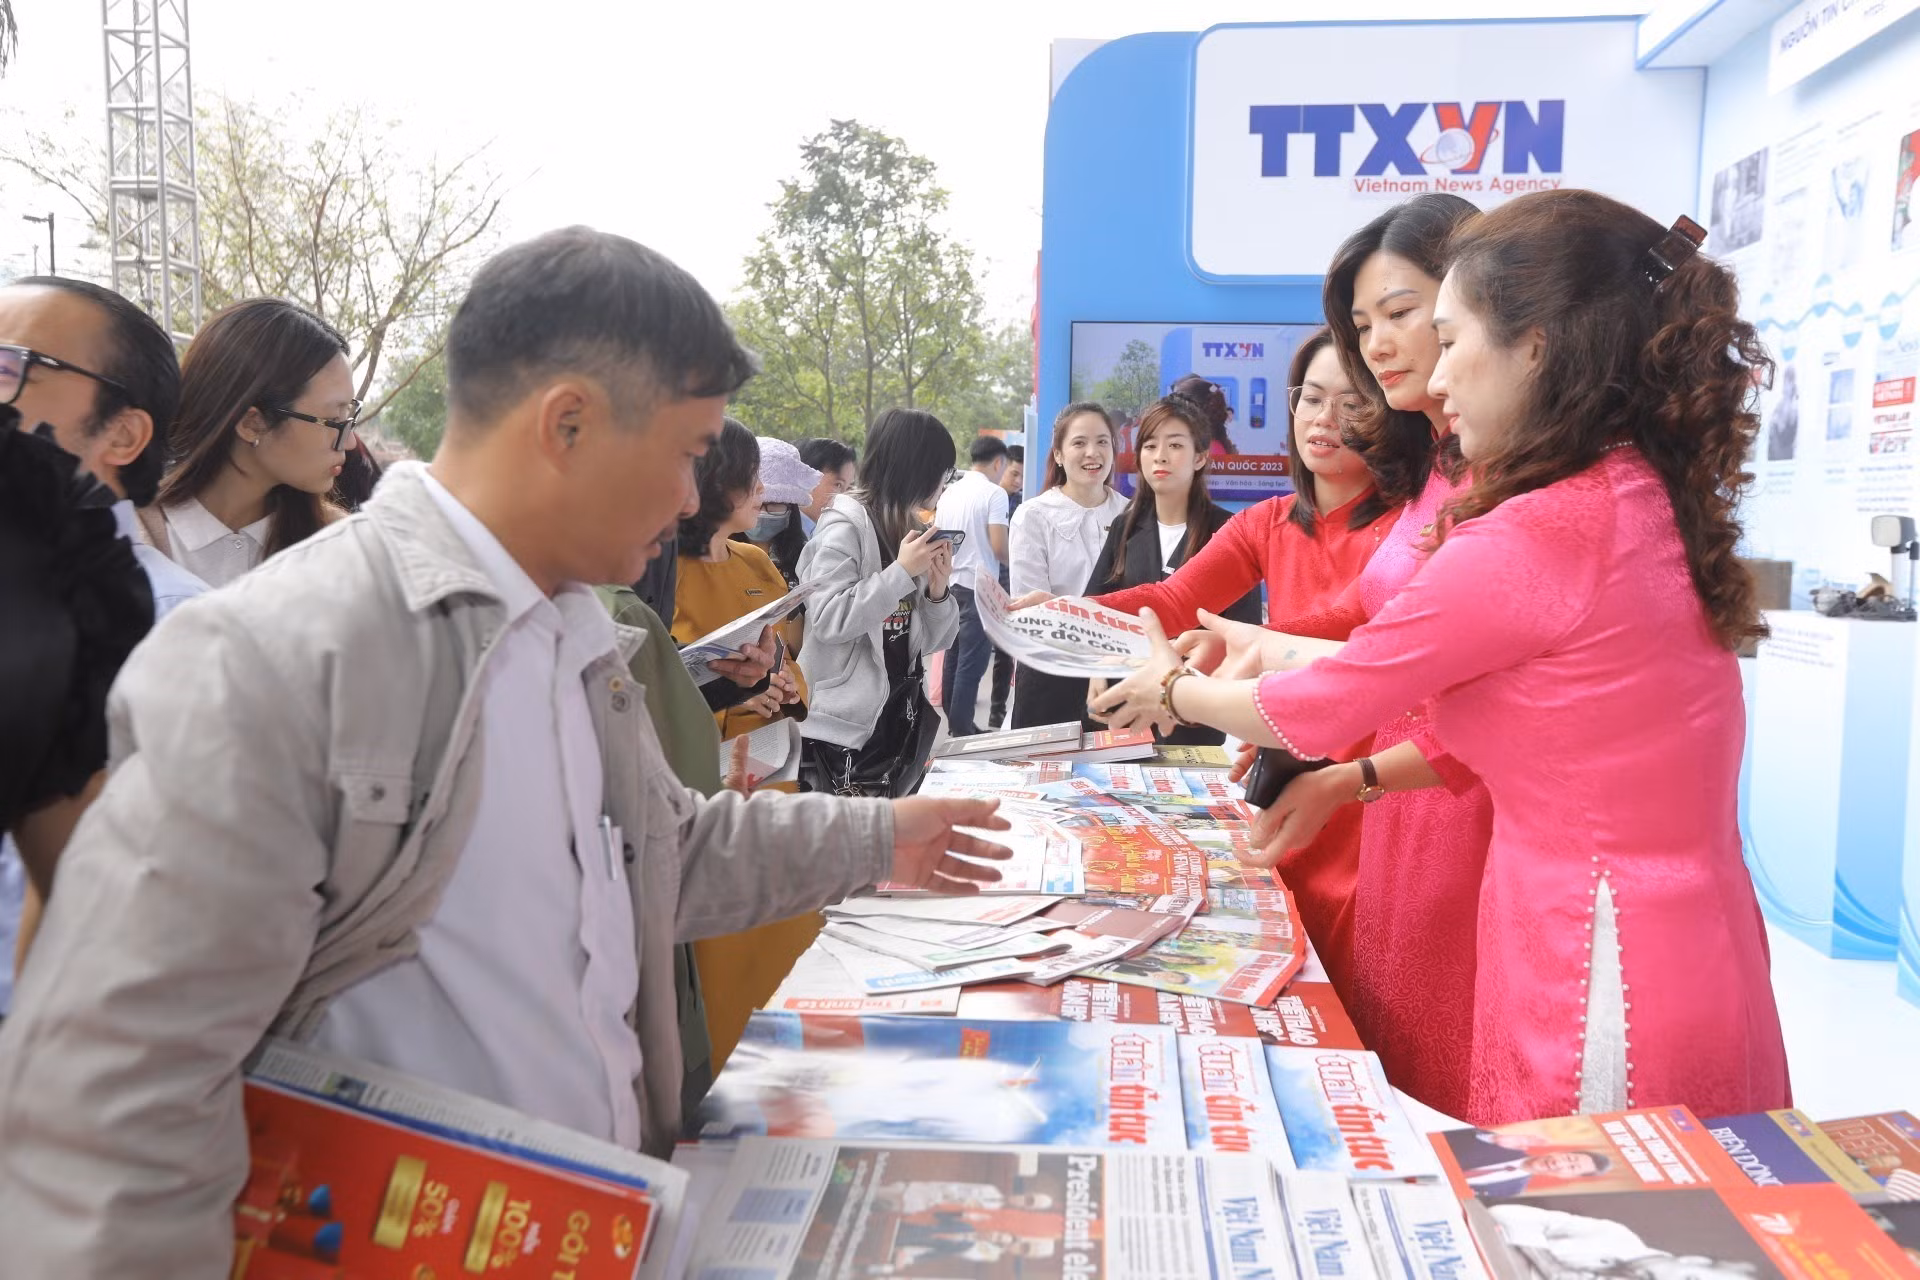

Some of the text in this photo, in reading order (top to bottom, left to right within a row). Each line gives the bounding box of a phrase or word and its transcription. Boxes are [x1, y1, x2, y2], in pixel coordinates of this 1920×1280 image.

[1249, 99, 1565, 177] TTXVN
[1354, 176, 1562, 195] Vietnam News Agency
[1202, 342, 1264, 358] TTXVN
[1209, 458, 1283, 472] ÀN QUỐC 2023
[412, 1179, 450, 1239] 50%
[1062, 1155, 1099, 1250] President
[490, 1199, 532, 1269] 100%
[556, 1209, 592, 1265] GÓI
[1229, 1228, 1265, 1264] Nam
[1311, 1238, 1351, 1276] Nam
